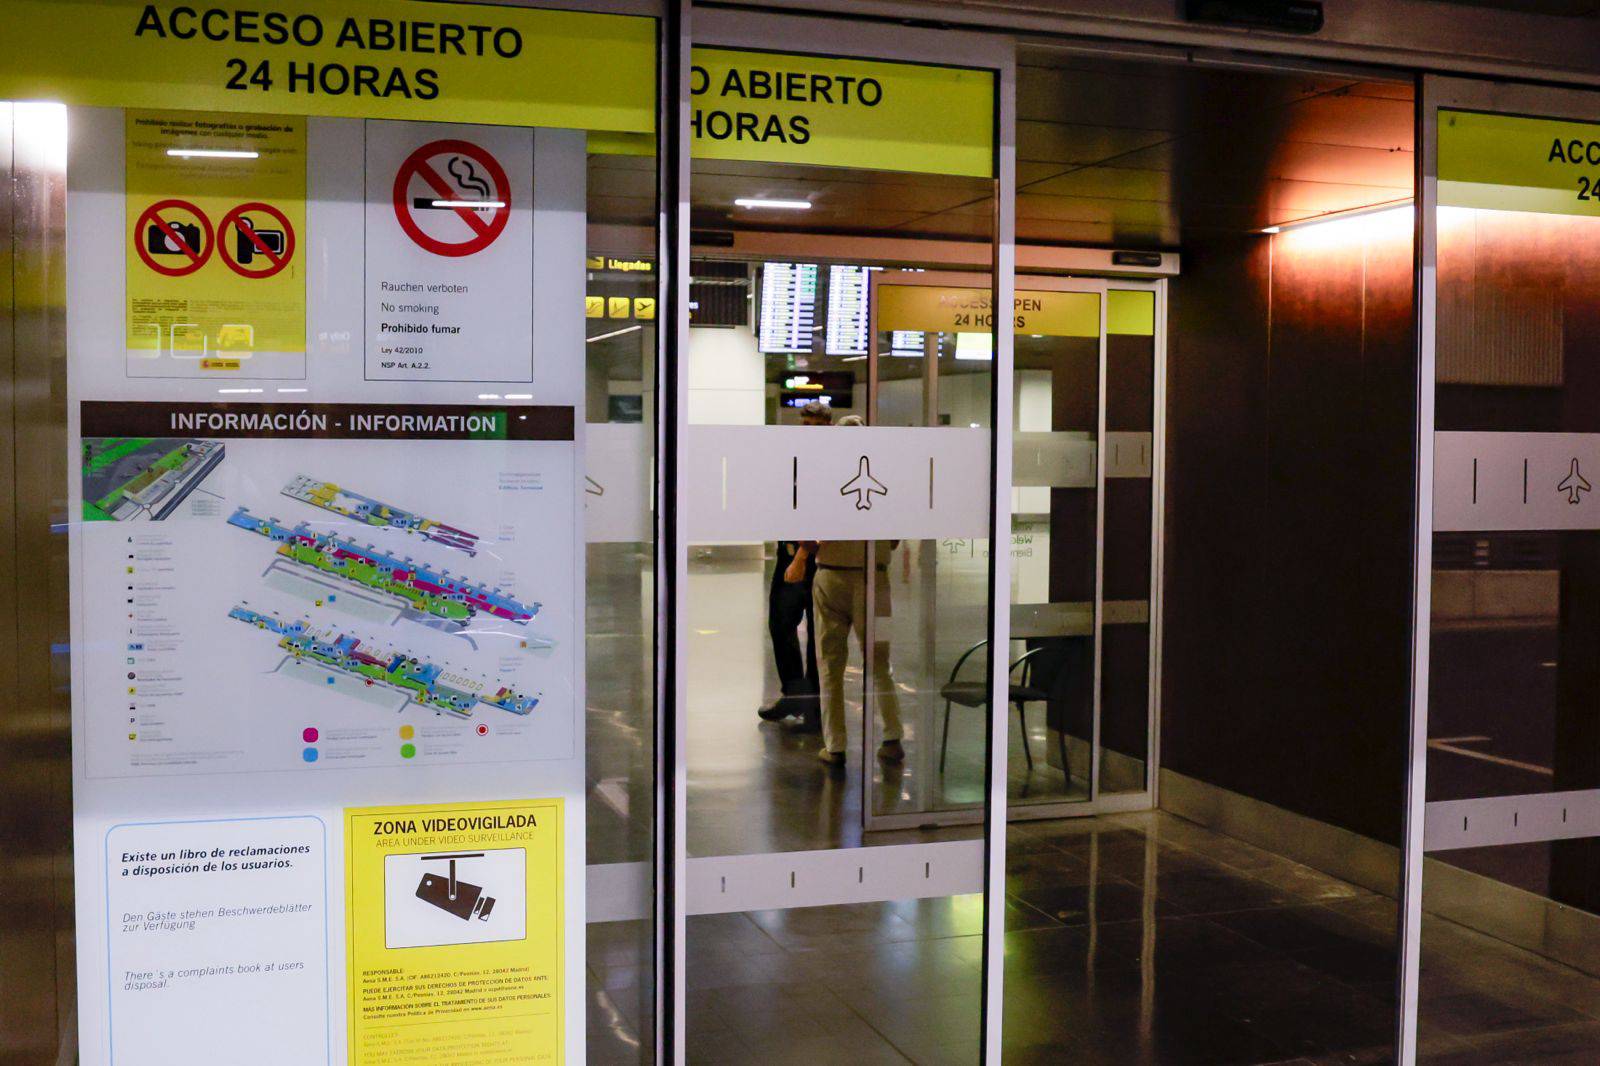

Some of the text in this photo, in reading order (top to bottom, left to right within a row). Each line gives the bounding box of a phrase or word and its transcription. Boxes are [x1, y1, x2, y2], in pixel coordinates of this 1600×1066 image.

[135, 4, 524, 59] ACCESO ABIERTO
[226, 59, 440, 100] 24 HORAS
[720, 68, 883, 107] ABIERTO
[1548, 138, 1600, 166] ACC
[1577, 176, 1600, 201] 24
[608, 259, 651, 272] Llegadas
[381, 281, 469, 294] Rauchen verboten
[381, 302, 440, 315] No smoking
[1014, 299, 1041, 311] PEN
[381, 323, 461, 334] Prohibido fumar
[954, 313, 969, 326] 24
[381, 347, 393, 355] Ley
[169, 409, 327, 433] INFORMACIÓN
[349, 414, 497, 433] INFORMATION
[374, 814, 537, 835] ZONA VIDEOVIGILADA
[375, 831, 534, 848] AREA UNDER VIDEO SURVEILLANCE
[121, 844, 311, 863] Existe un libro de reclamaciones
[121, 858, 293, 877] a disposición de los usuarios.
[122, 912, 143, 923] Den
[180, 909, 214, 919] stehen
[122, 923, 138, 932] zur
[124, 971, 153, 981] There
[167, 971, 174, 979] a
[177, 964, 234, 978] complaints
[237, 963, 261, 973] book
[264, 962, 275, 972] at
[278, 961, 304, 971] users
